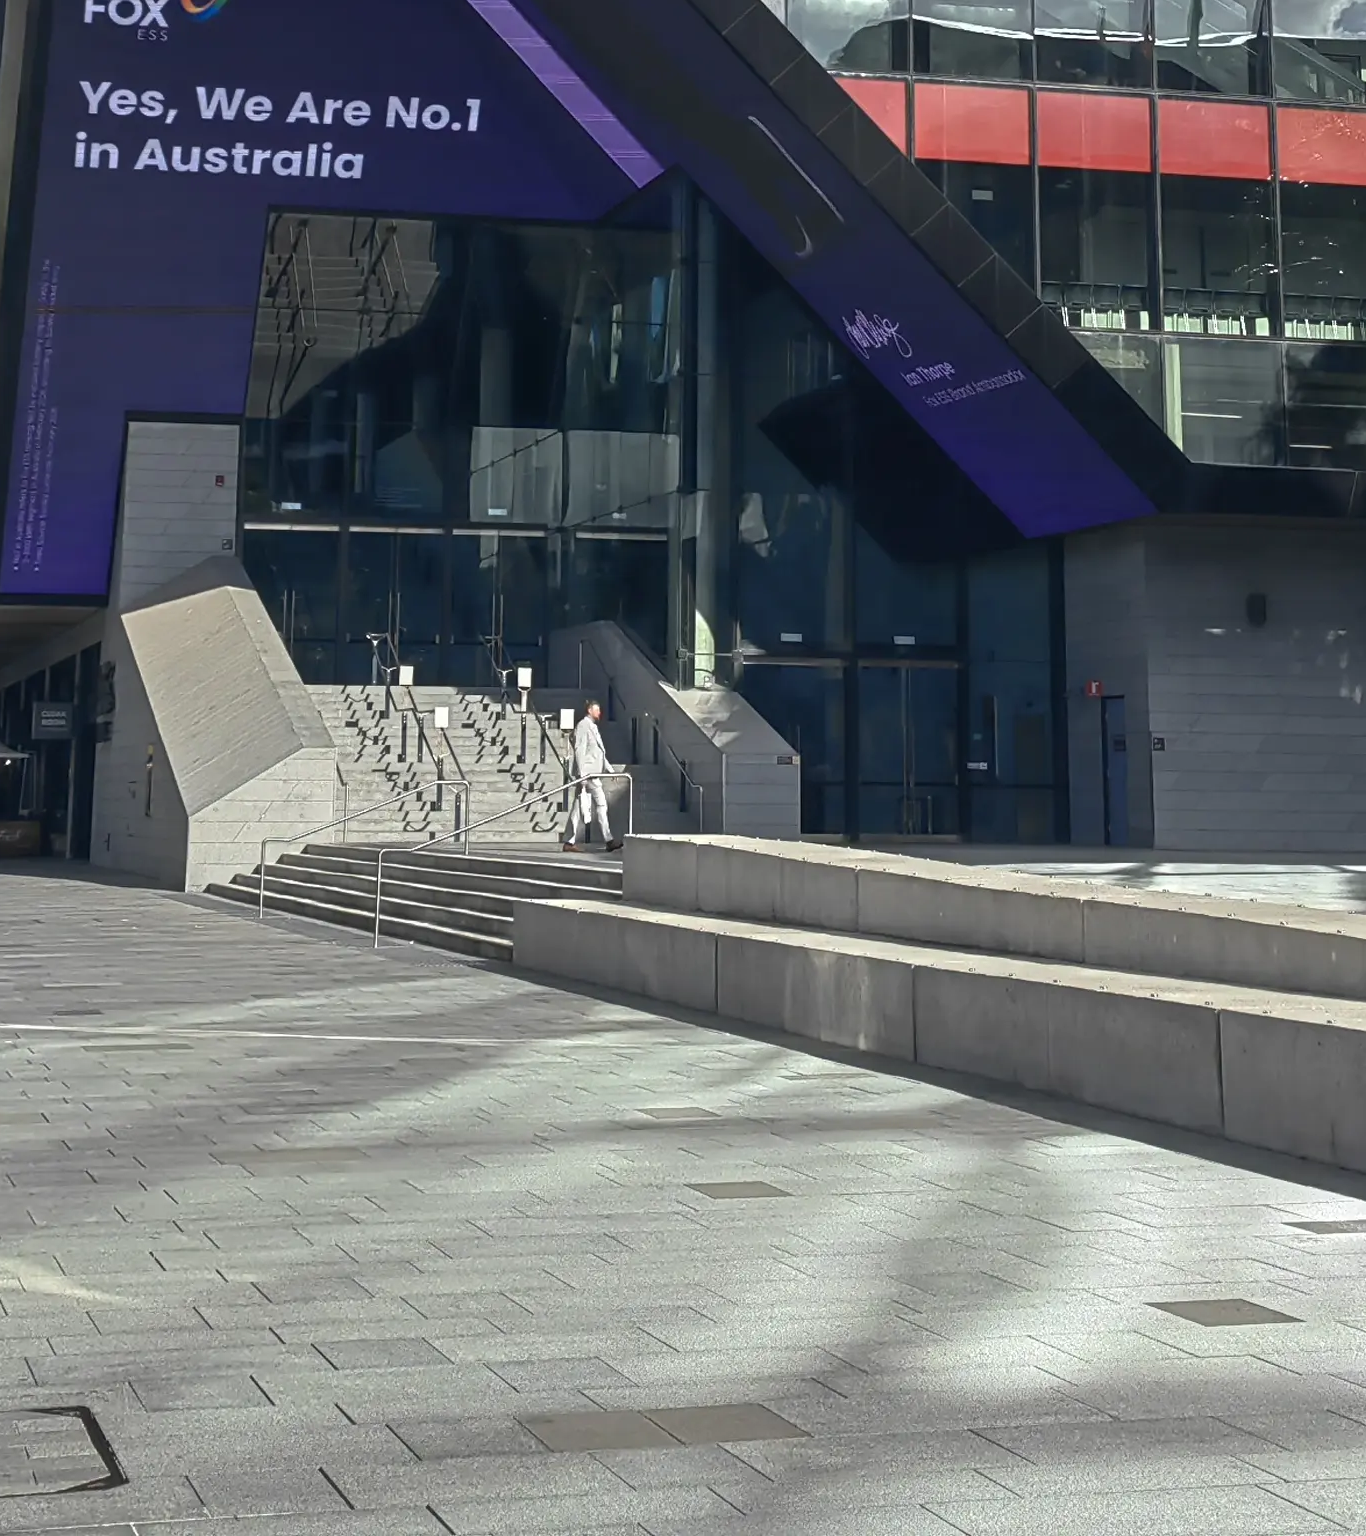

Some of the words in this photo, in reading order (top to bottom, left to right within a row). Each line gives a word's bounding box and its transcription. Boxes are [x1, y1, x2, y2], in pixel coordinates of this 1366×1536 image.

[137, 28, 169, 42] ESS
[78, 80, 179, 124] Yes,
[195, 86, 274, 122] We
[285, 91, 372, 127] Are
[385, 95, 482, 132] No.1
[73, 130, 120, 170] in
[133, 137, 365, 180] Australia
[899, 371, 924, 387] Ian
[915, 361, 956, 381] Thorpe
